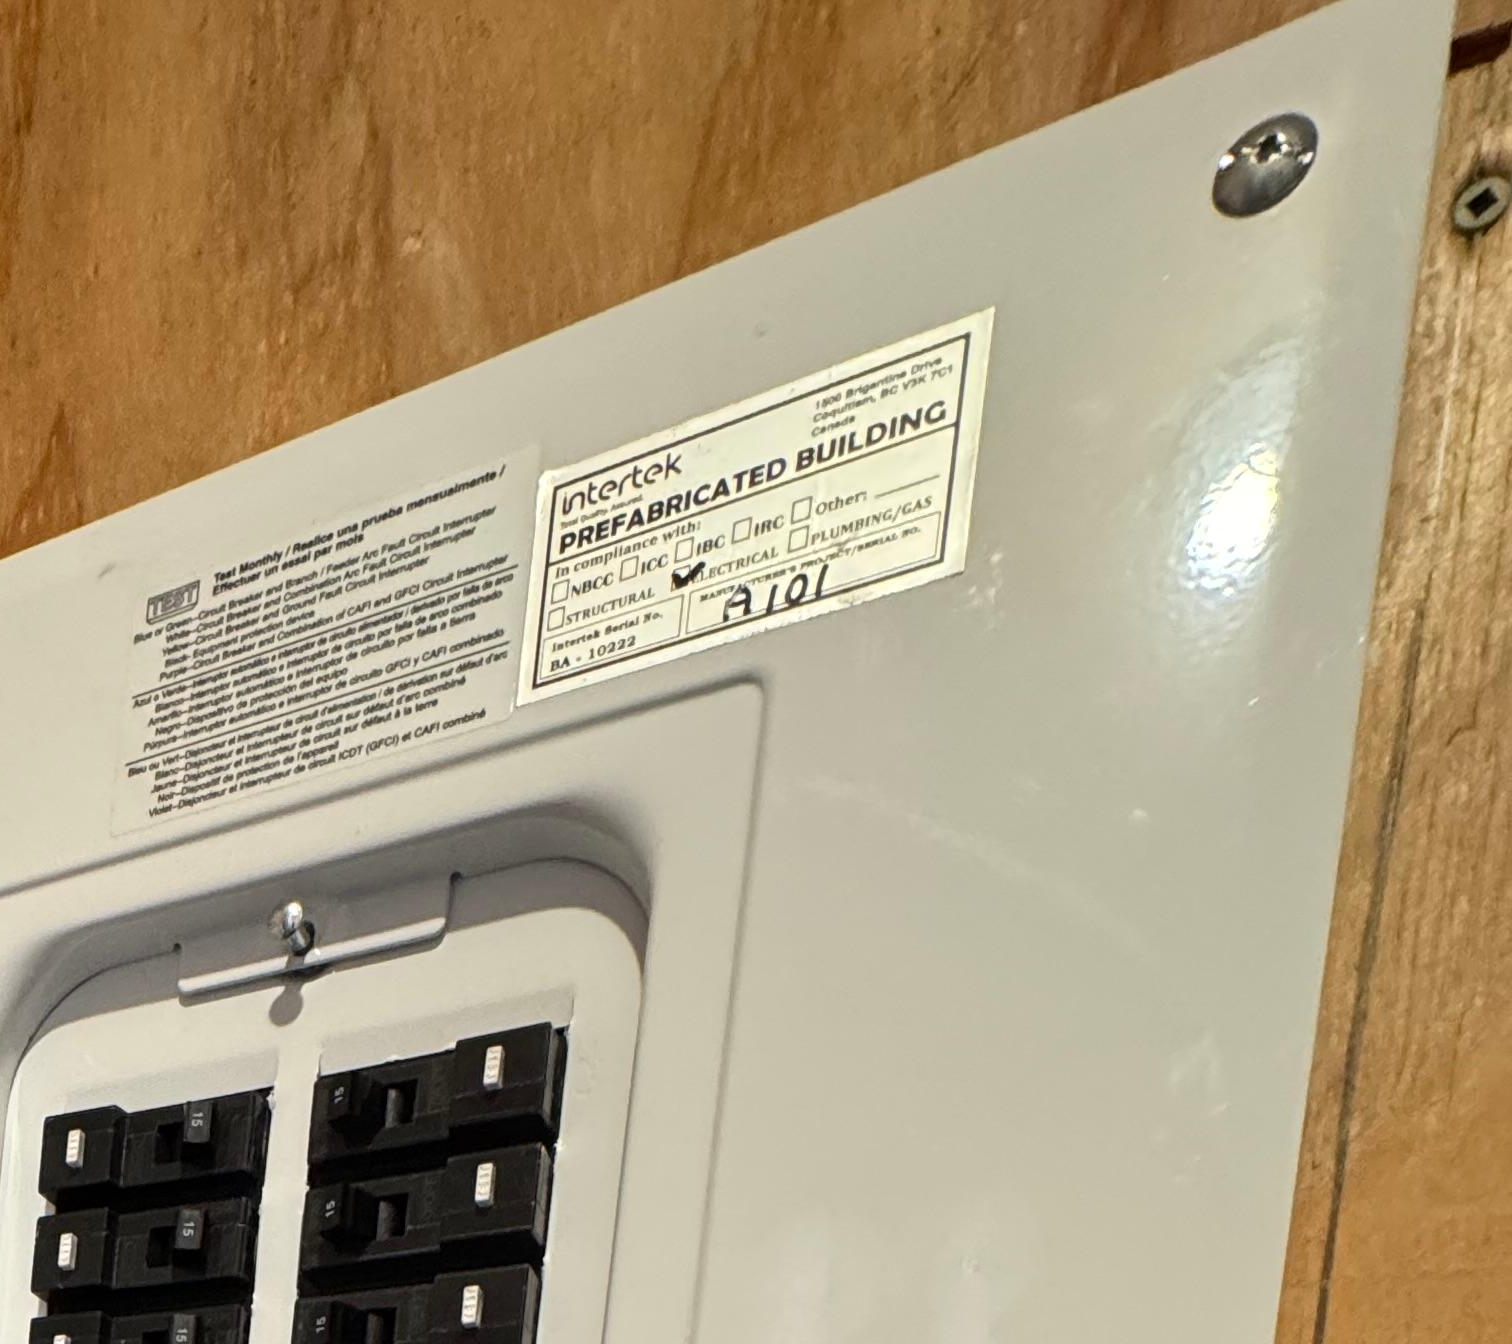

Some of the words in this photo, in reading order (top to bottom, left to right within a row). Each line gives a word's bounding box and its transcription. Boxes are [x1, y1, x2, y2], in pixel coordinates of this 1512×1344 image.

[910, 354, 942, 375] Drive
[879, 383, 898, 399] BC
[810, 412, 856, 438] Canada
[558, 454, 788, 555] PREFABRICATED
[795, 397, 947, 472] BUILDING
[561, 447, 684, 516] intertek
[814, 486, 868, 517] Other:
[213, 565, 236, 584] Test
[238, 548, 282, 577] Monthly
[292, 529, 333, 554] Realice
[336, 522, 358, 538] una
[361, 504, 403, 531] prueba
[406, 468, 497, 512] mensualmente
[753, 513, 785, 537] IRC
[810, 494, 932, 548] PLUMBING/GAS
[555, 563, 570, 579] In
[573, 533, 658, 575] compliance
[662, 517, 701, 543] with:
[695, 534, 726, 556] IBC
[640, 552, 669, 575] ICC
[570, 571, 614, 598] NBCC
[722, 563, 830, 624] A101
[565, 585, 656, 626] STRUCTURAL
[551, 628, 600, 653] Intertek
[604, 614, 640, 636] Serial
[642, 607, 663, 624] No.
[550, 655, 571, 672] BA
[588, 634, 636, 660] 10222
[334, 1086, 344, 1104] 15
[191, 1112, 203, 1128] 15
[325, 1200, 336, 1217] 15
[183, 1221, 194, 1237] 15
[176, 1328, 187, 1343] 15
[316, 1316, 326, 1332] 15
